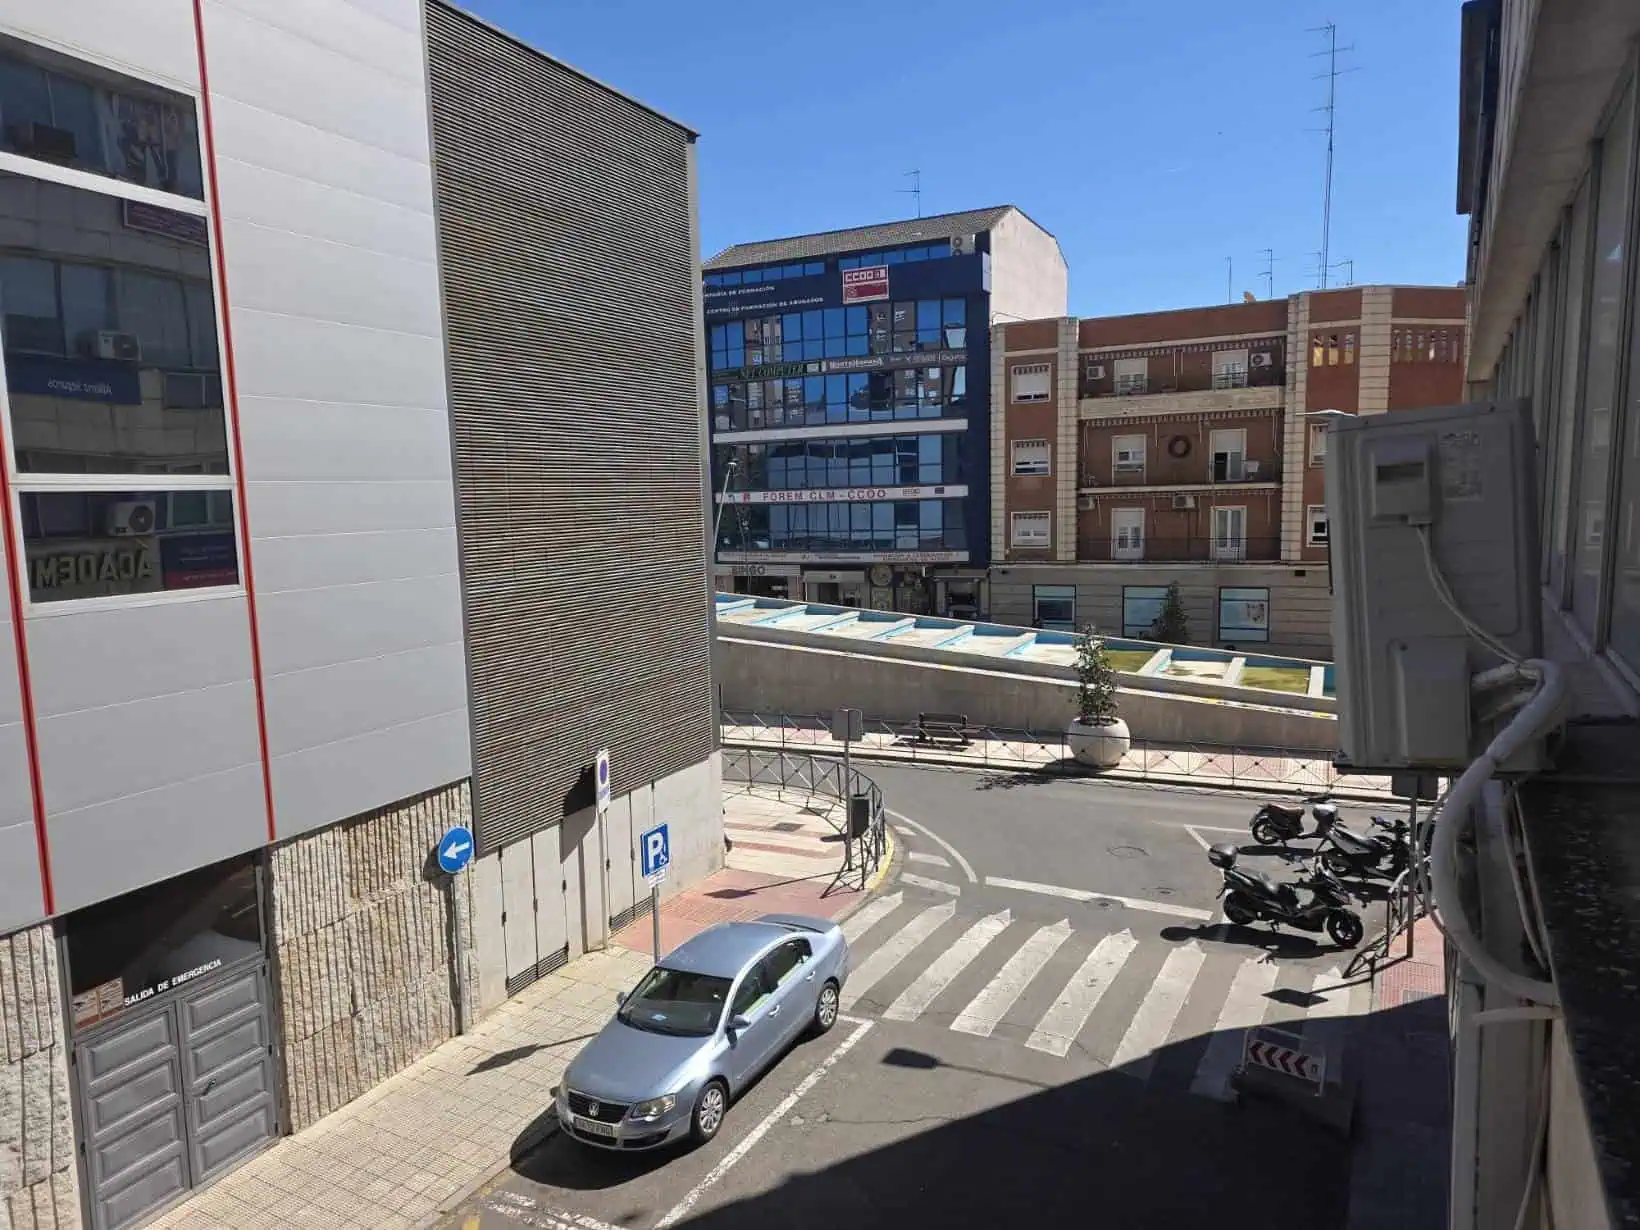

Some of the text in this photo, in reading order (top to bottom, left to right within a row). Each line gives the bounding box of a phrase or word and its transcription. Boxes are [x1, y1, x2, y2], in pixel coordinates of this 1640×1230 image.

[762, 491, 804, 501] FOREM
[847, 488, 886, 500] CCOO
[124, 958, 222, 1007] SALIDA DE EMERGENCIA
